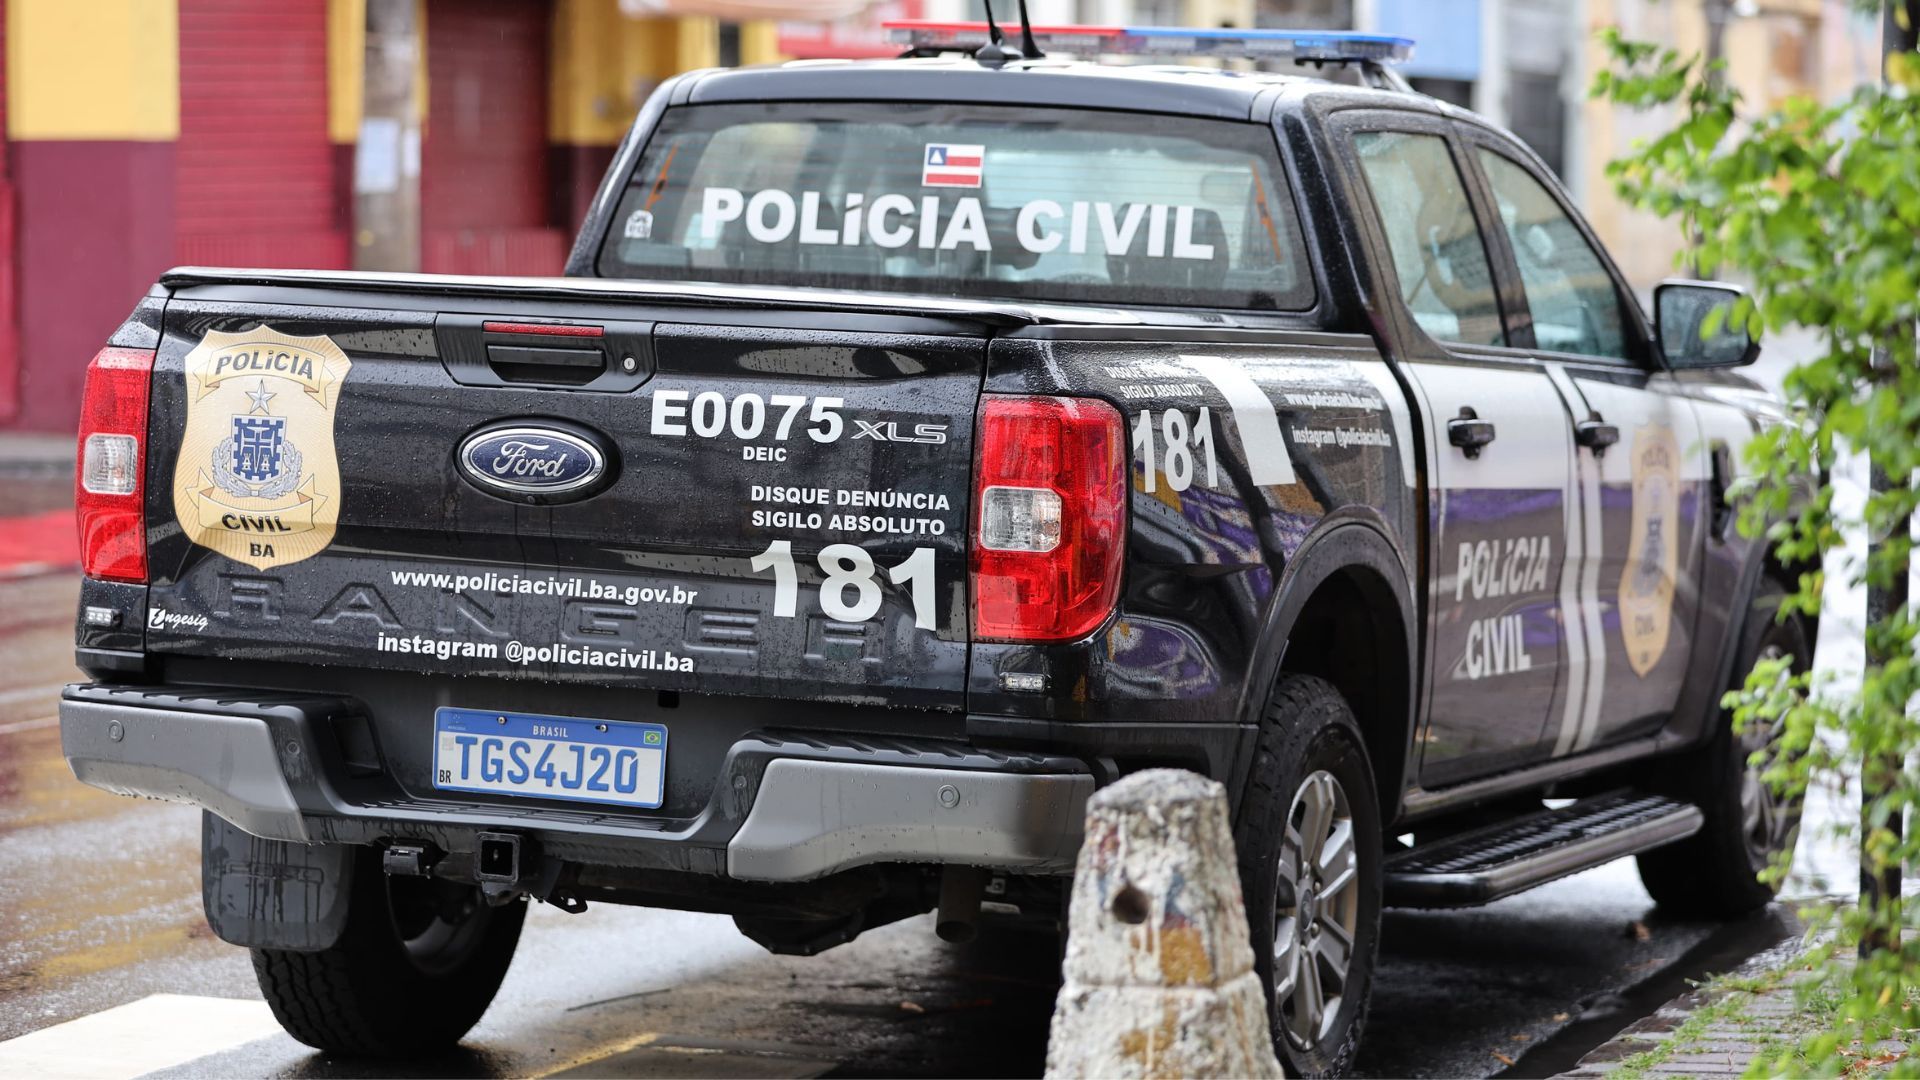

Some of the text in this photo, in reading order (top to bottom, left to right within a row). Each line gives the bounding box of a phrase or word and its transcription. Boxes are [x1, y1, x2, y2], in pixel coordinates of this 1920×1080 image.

[1016, 199, 1215, 260] CIVIL
[1120, 383, 1203, 399] SIGILO ABSOLUTO
[650, 389, 844, 443] E0075
[851, 419, 949, 445] XLS
[1291, 425, 1336, 448] instagram
[493, 441, 568, 477] Ford
[743, 446, 787, 462] DEIC
[1133, 406, 1218, 493] 181
[751, 485, 950, 511] DISQUE DENÚNCIA
[222, 514, 291, 533] CIVIL
[752, 510, 945, 535] SIGILO ABSOLUTO
[250, 542, 275, 558] BA
[391, 571, 698, 605] www.policiacivil.ba.gov.br
[751, 540, 936, 631] 181
[214, 572, 884, 663] RANGER
[377, 632, 694, 673] instagram @policiacivil.ba
[1466, 614, 1531, 680] CIVIL
[533, 724, 568, 738] BRASIL
[439, 769, 452, 784] BR
[455, 735, 638, 794] TGS4J20
